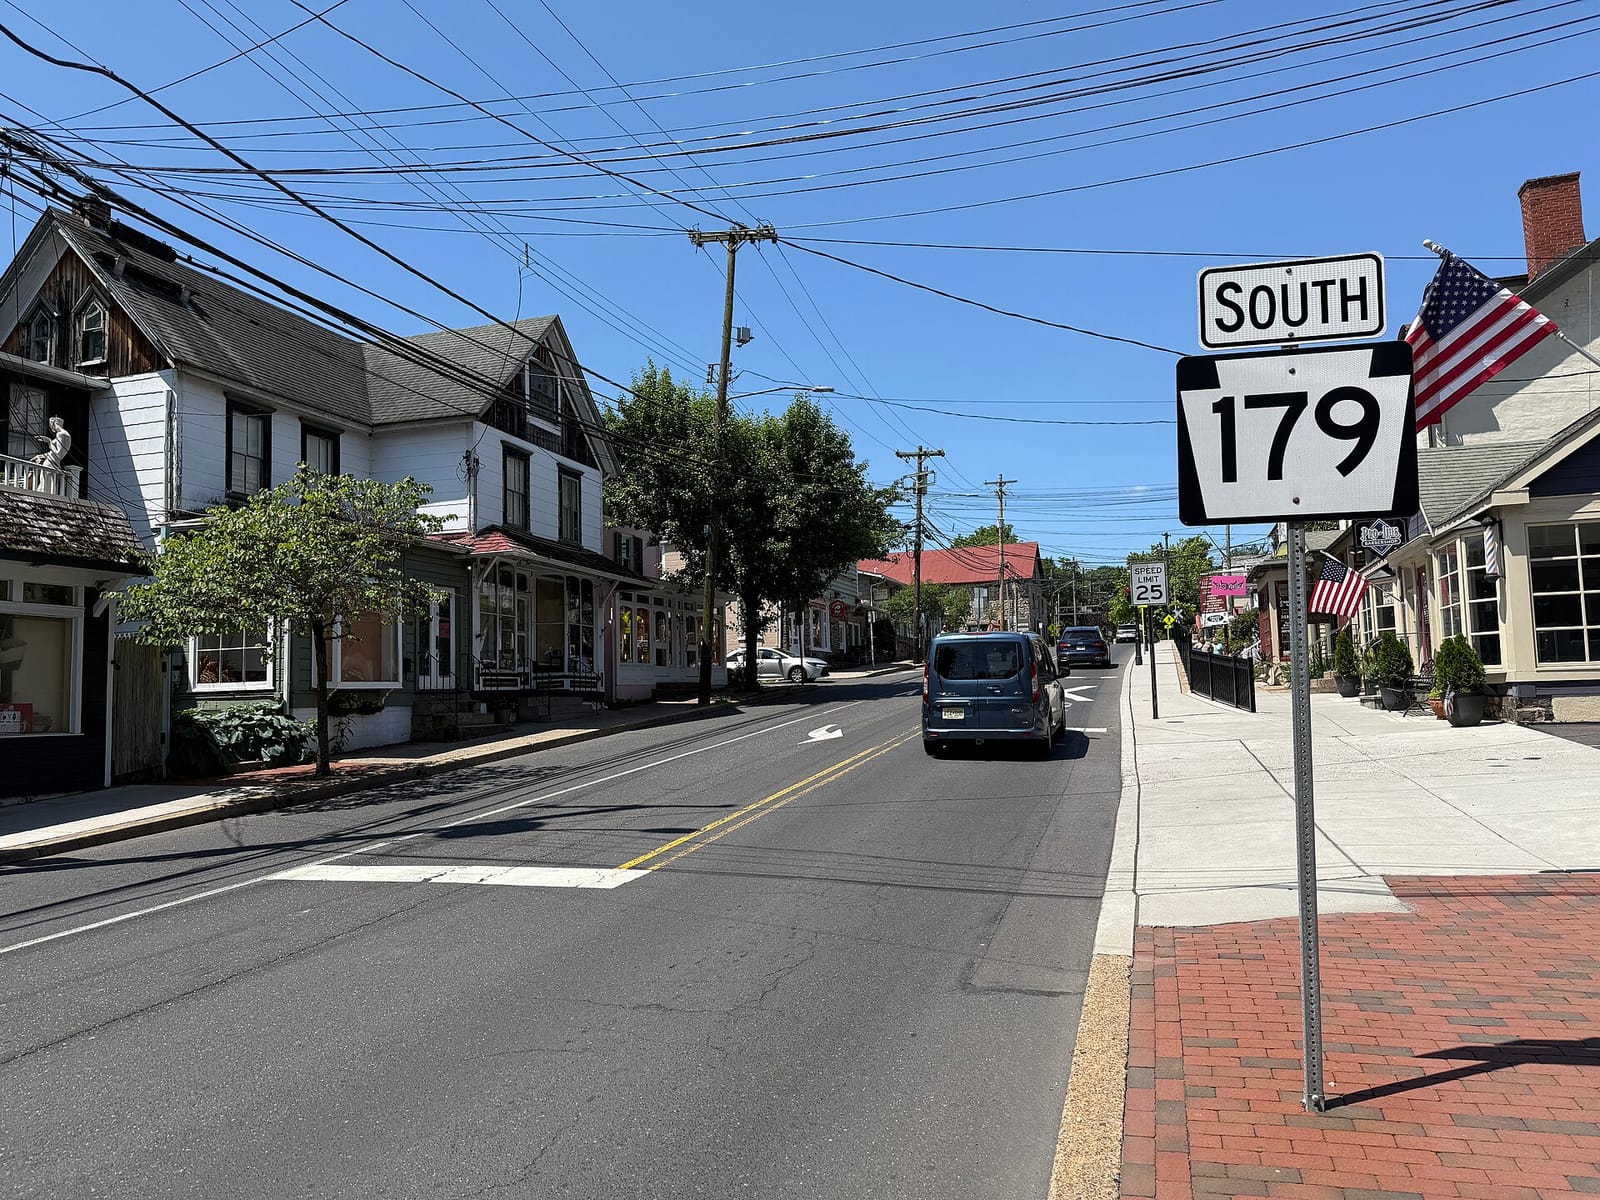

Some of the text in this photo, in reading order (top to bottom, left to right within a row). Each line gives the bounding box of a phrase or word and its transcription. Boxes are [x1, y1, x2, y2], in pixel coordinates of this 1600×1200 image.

[1214, 276, 1368, 333] SOUTH
[1212, 386, 1381, 483] 179
[1134, 567, 1162, 575] SPEED
[1136, 584, 1162, 600] 25
